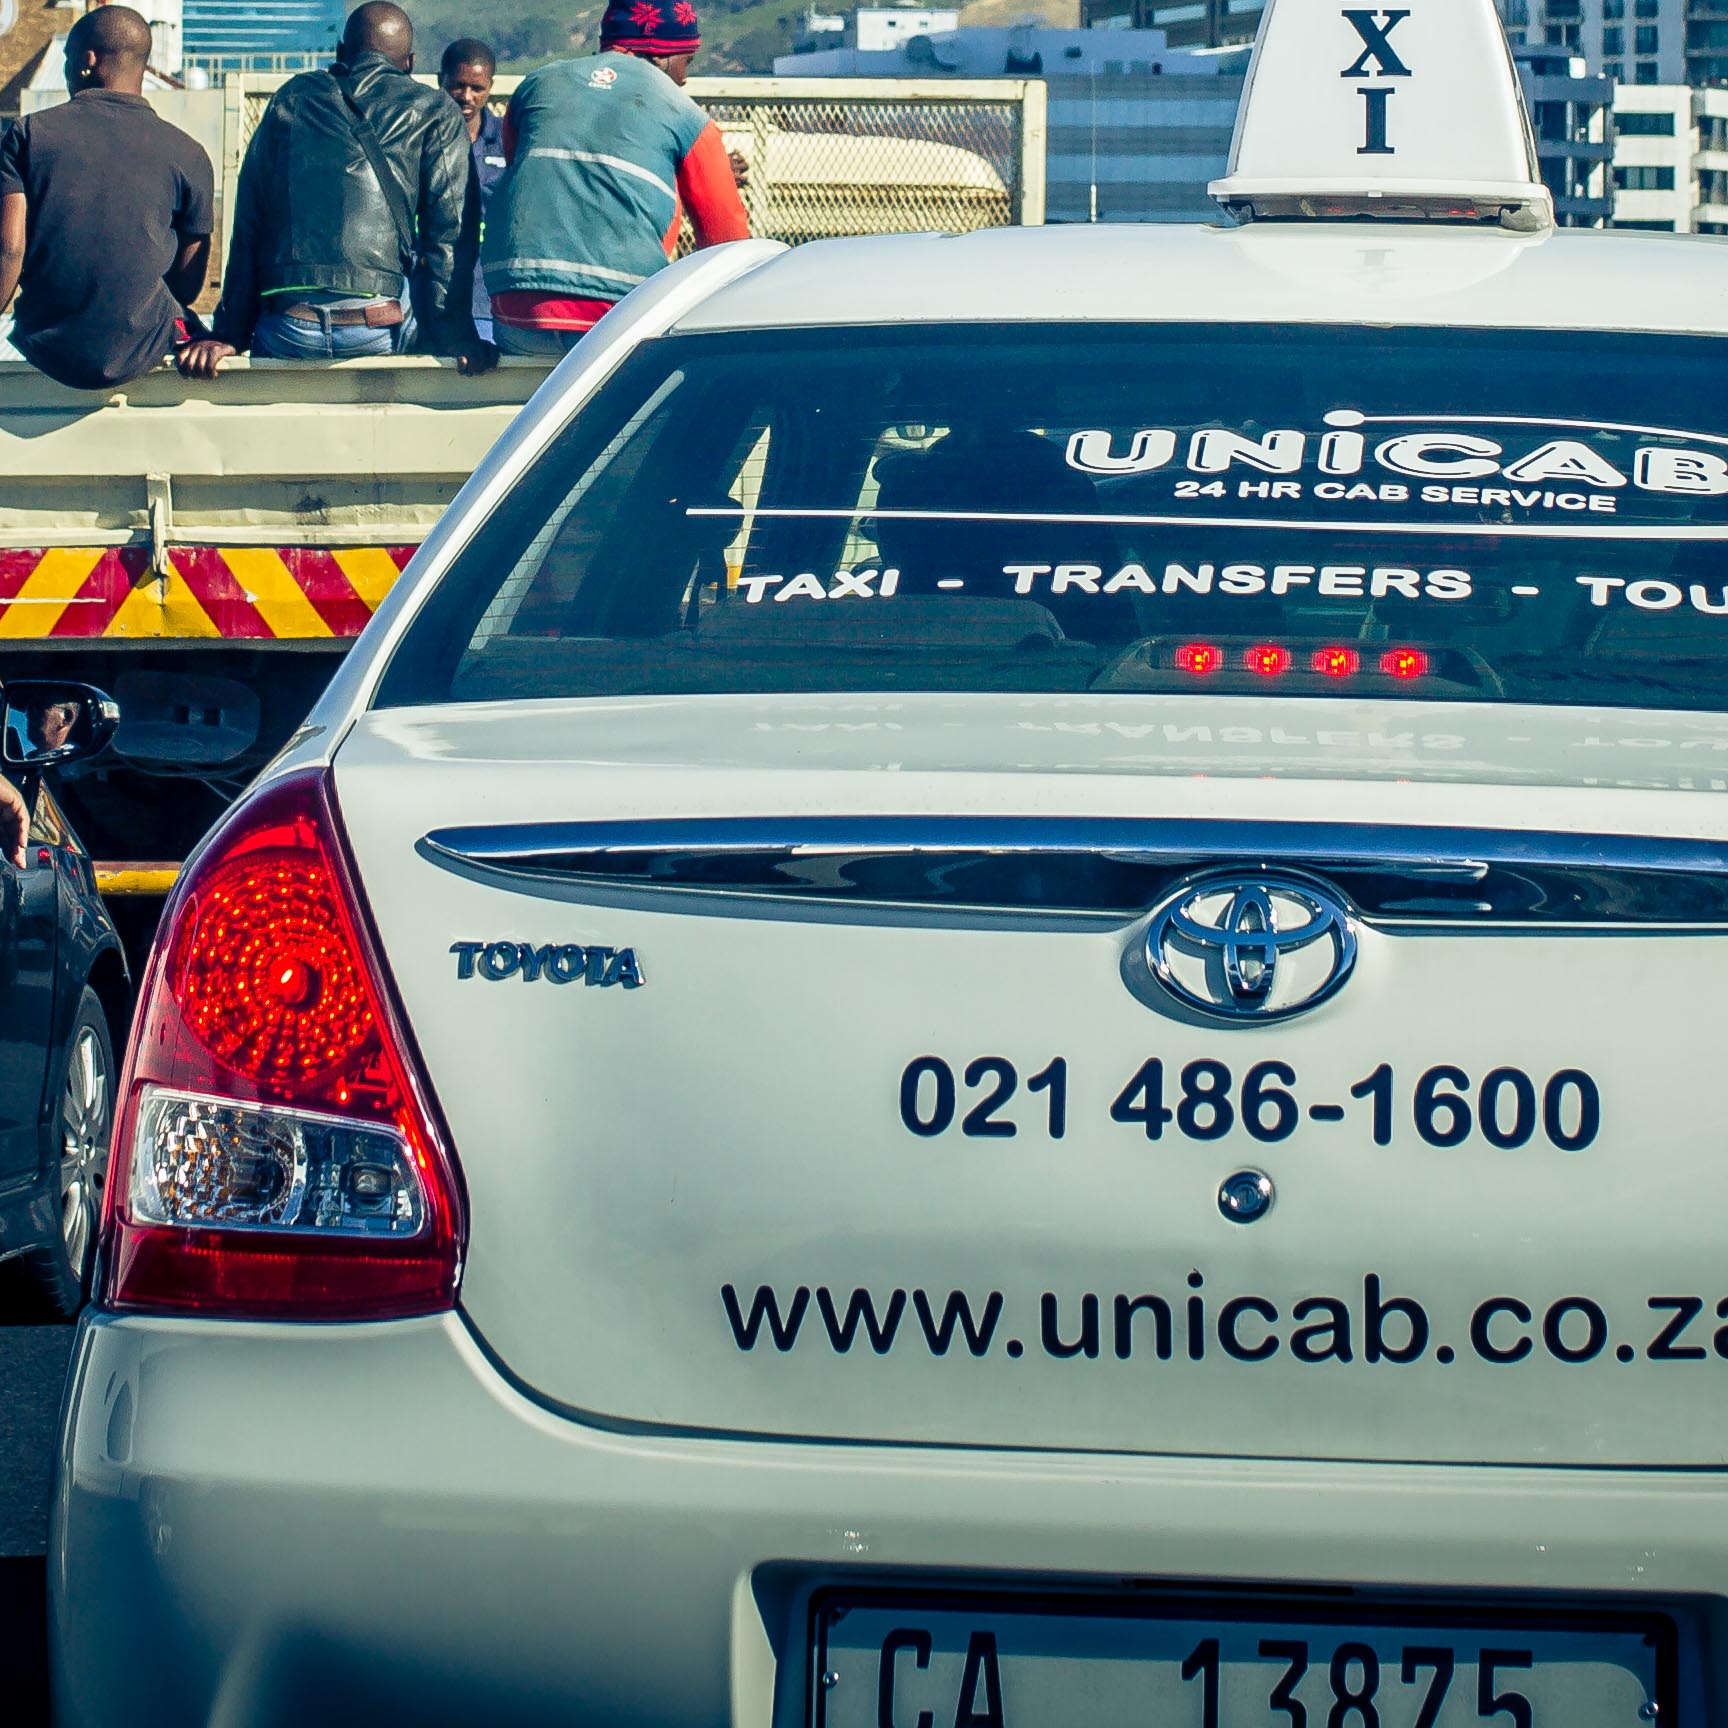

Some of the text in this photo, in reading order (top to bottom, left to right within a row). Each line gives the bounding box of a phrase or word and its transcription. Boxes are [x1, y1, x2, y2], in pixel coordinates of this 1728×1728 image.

[1174, 481, 1618, 513] 24 HR CAB SERVICE
[736, 569, 901, 603] TAXI
[1003, 563, 1473, 599] TRANSFERS
[449, 940, 646, 989] TOYOTA
[899, 1055, 1601, 1152] 021 486-1600
[877, 1627, 1536, 1728] CA 13875
